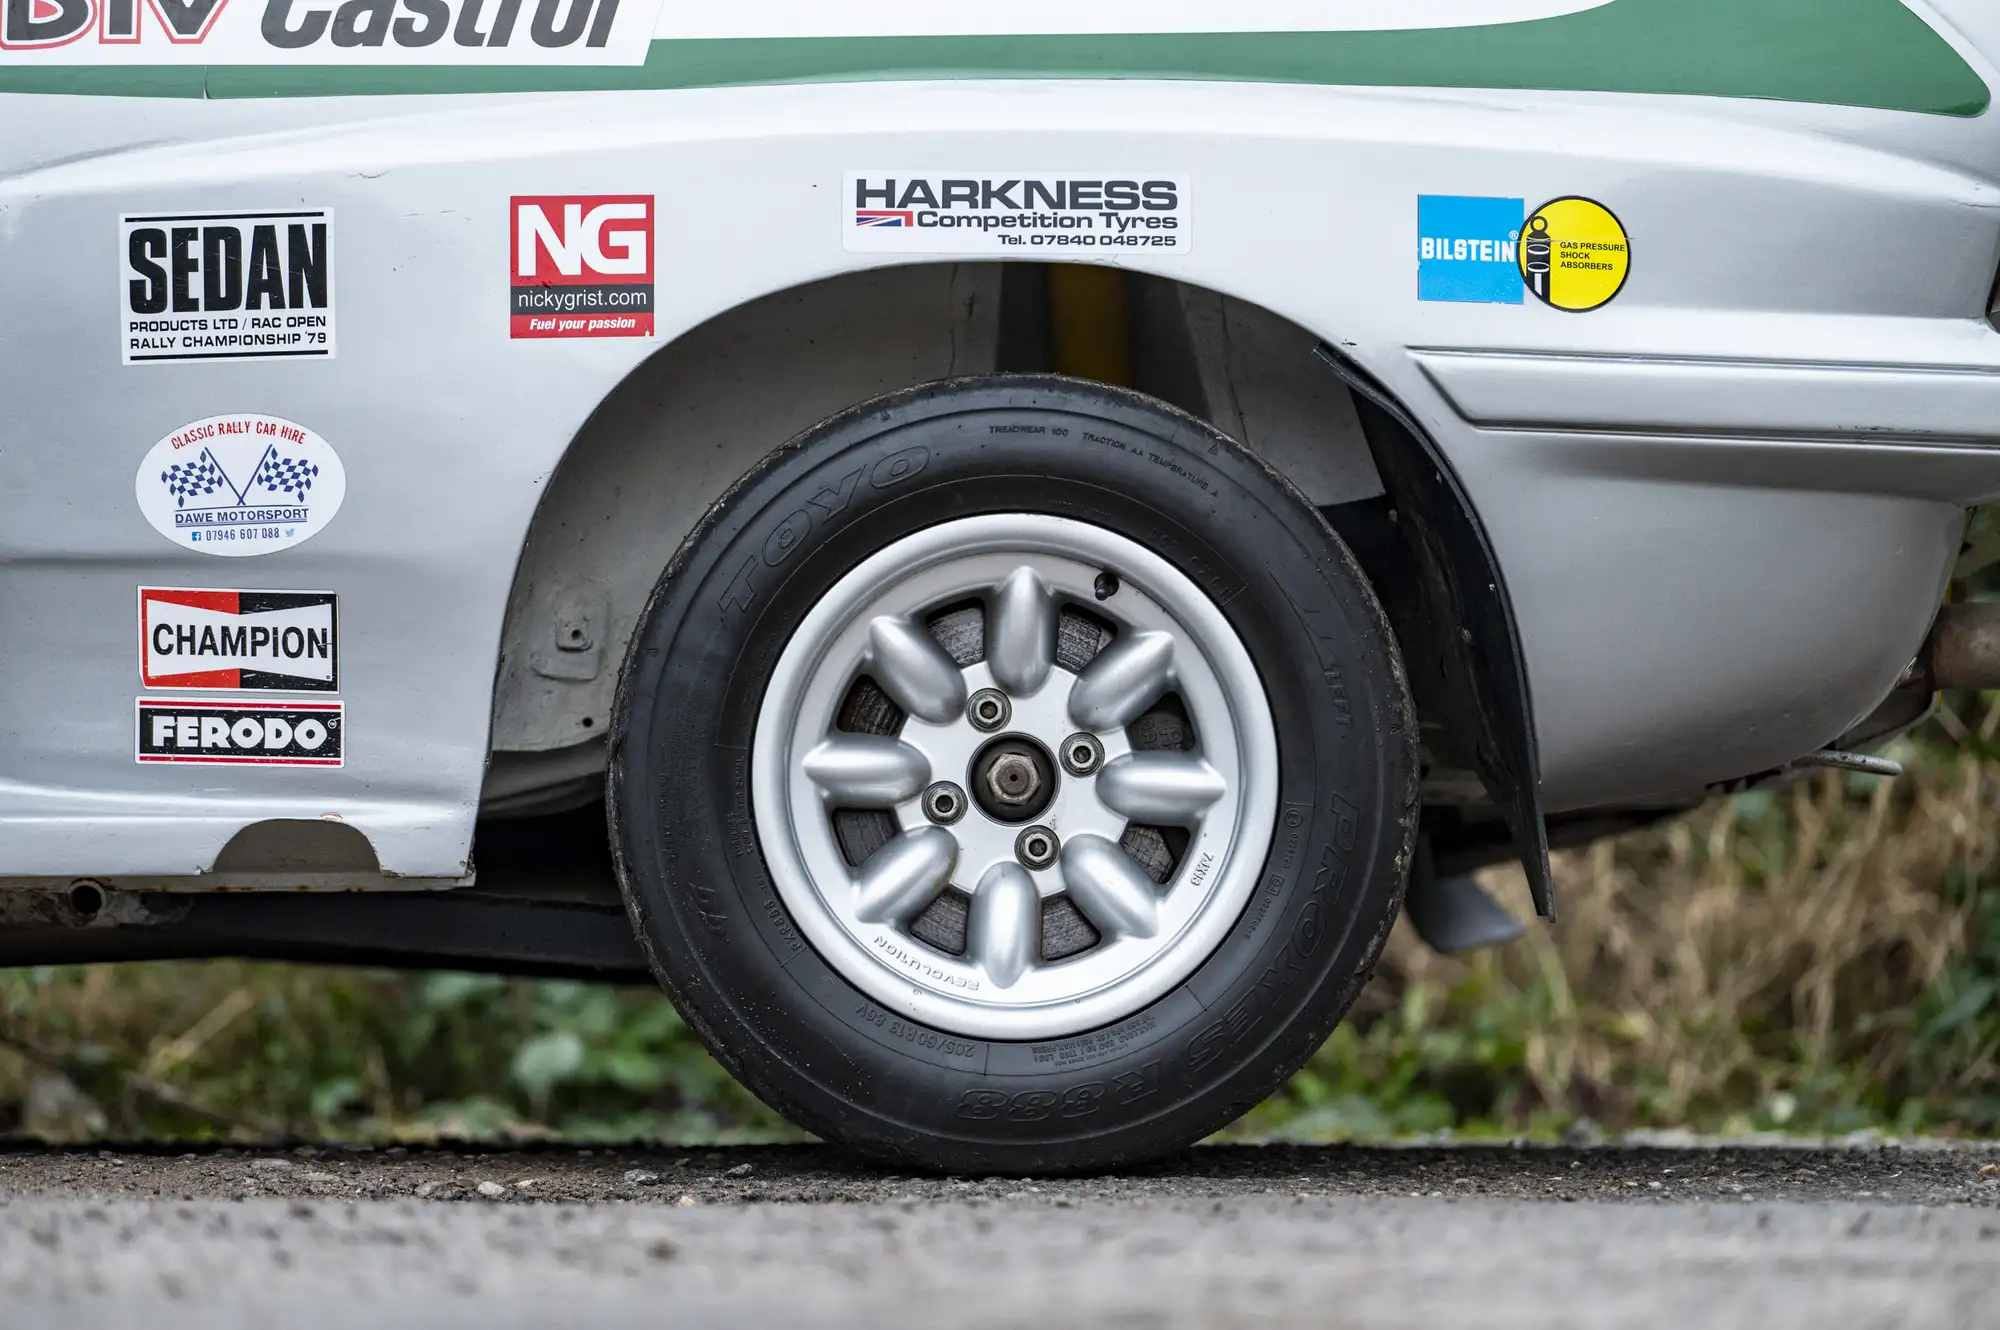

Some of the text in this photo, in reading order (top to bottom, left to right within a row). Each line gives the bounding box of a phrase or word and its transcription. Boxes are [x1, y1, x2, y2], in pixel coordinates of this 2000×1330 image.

[856, 178, 1178, 211] HARKNESS
[917, 210, 1178, 234] Competition Tyres
[518, 203, 647, 276] NG
[997, 234, 1177, 247] Tel. 07840 048725
[1421, 237, 1516, 262] BILSTEIN
[1560, 241, 1626, 252] GAS PRESSURE
[129, 223, 328, 314] SEDAN
[1560, 251, 1590, 260] SHOCK
[1560, 261, 1613, 271] ABSORBERS
[518, 289, 647, 311] nickygrist.com
[129, 319, 208, 332] PRODUCTS
[213, 318, 238, 330] LTD
[251, 317, 282, 329] RAC
[286, 316, 326, 328] OPEN
[529, 317, 636, 332] Fuel your passion
[130, 336, 177, 349] RALLY
[182, 333, 301, 347] CHAMPIONSHIP
[171, 421, 307, 450] CLASSIC RALLY CAR HIRE
[989, 425, 1045, 434] TREADWEAR
[1051, 426, 1069, 436] 100
[1082, 432, 1127, 450] TRACTION
[1147, 452, 1210, 490] TEMPERATURE
[175, 508, 309, 524] DAWE MOTORSPORT
[206, 527, 280, 541] 07946 607 088
[717, 445, 932, 619] TOYO
[153, 623, 328, 659] CHAMPION
[1323, 663, 1355, 730] LEFT
[152, 715, 328, 749] FERODO
[874, 935, 980, 991] REVOLUTION
[956, 792, 1360, 1122] PROXES R888
[886, 1018, 975, 1059] 205/60R13
